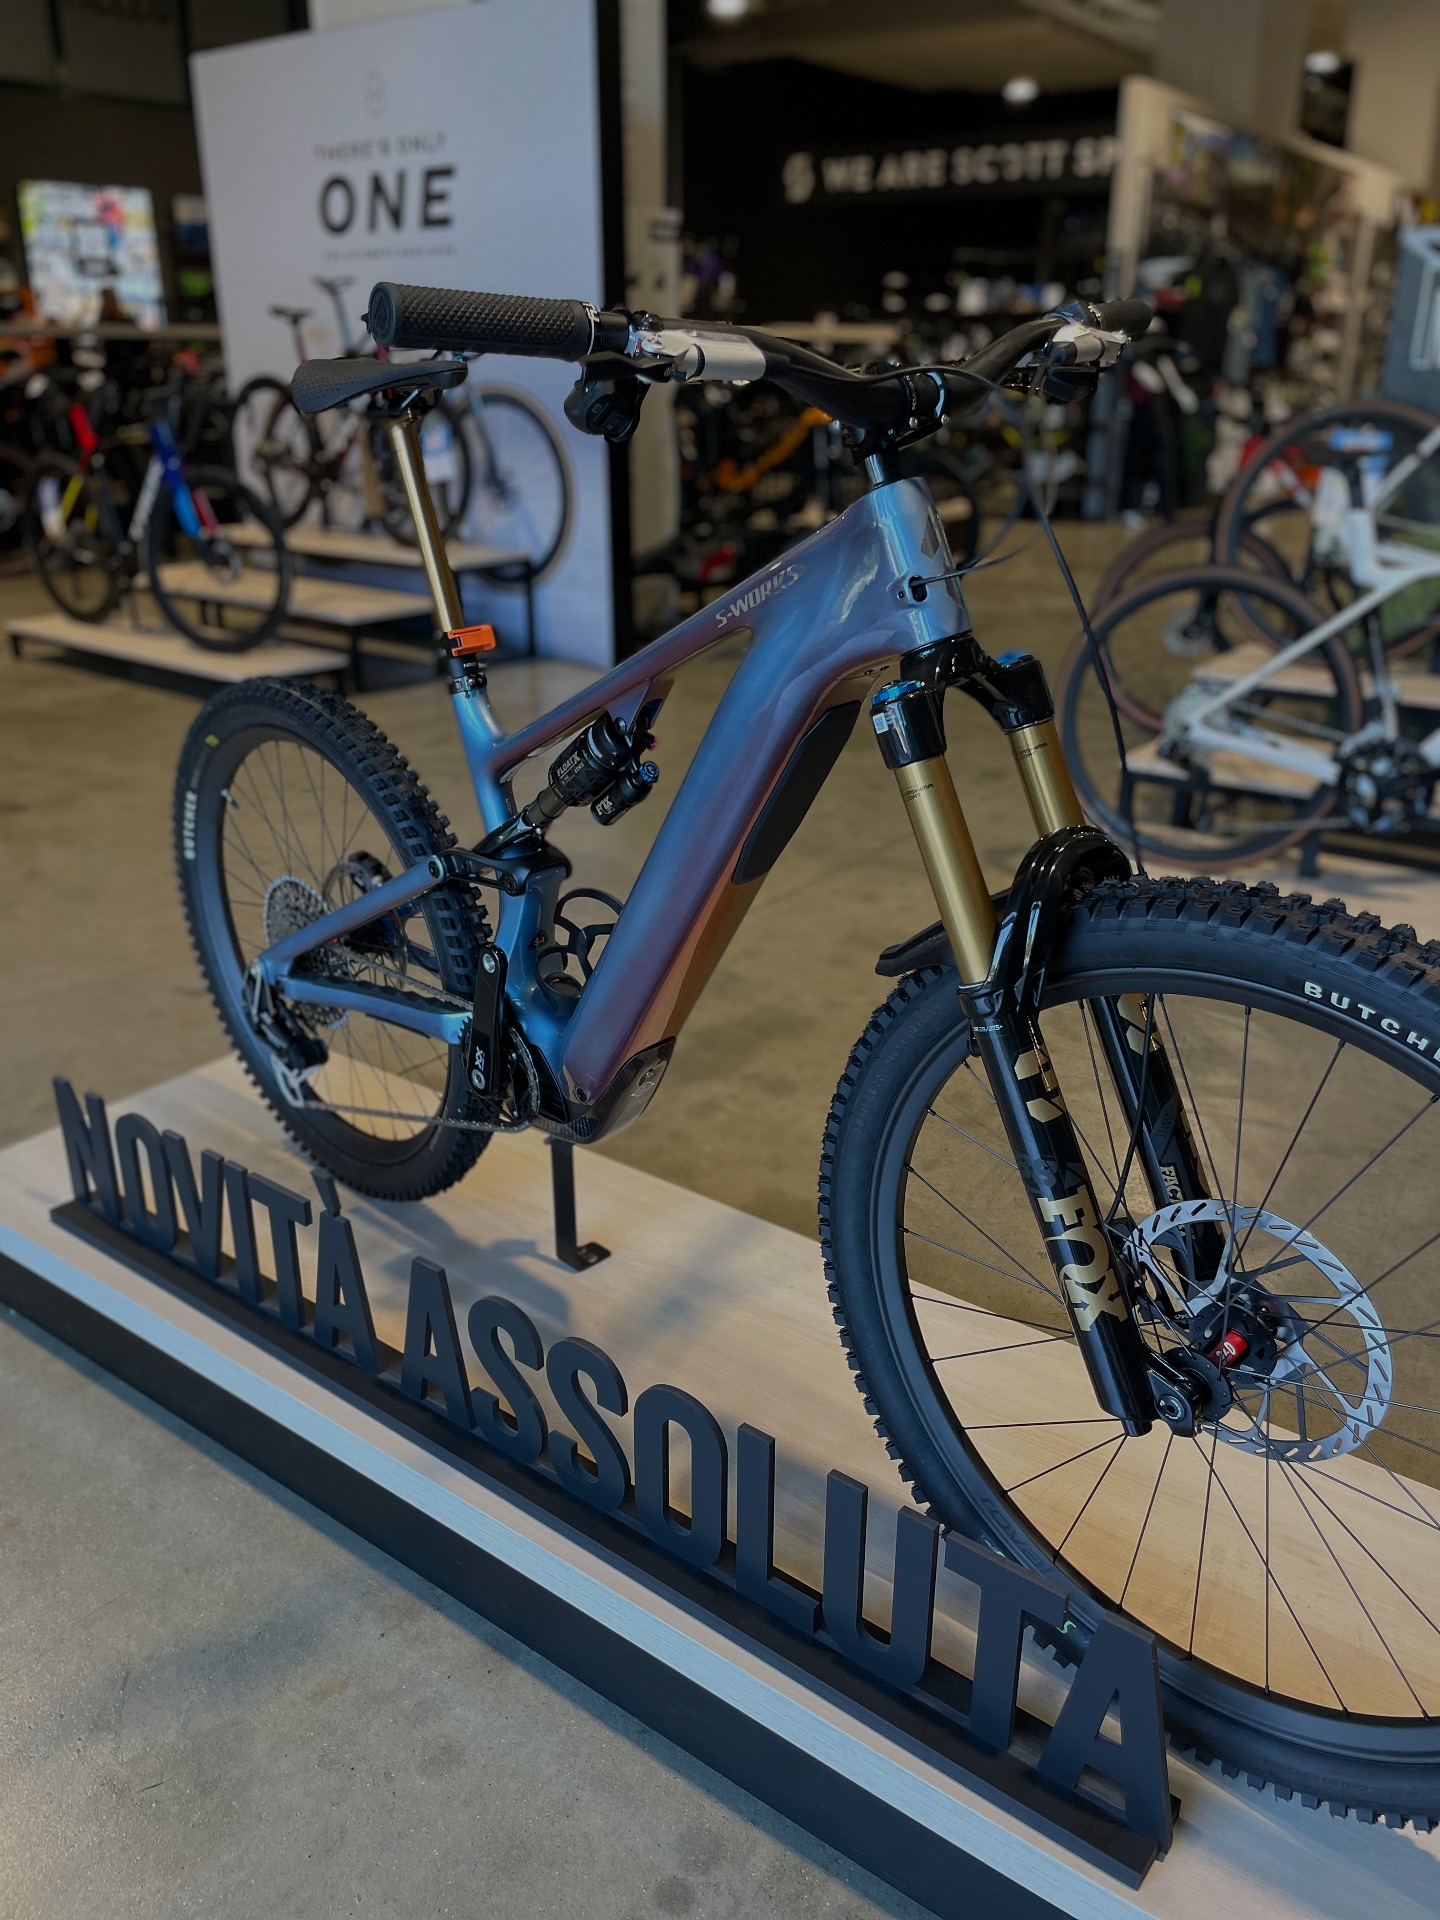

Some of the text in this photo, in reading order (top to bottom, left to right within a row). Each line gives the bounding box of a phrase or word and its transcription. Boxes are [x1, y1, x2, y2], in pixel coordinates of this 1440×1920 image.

[821, 153, 875, 194] WE
[875, 147, 948, 191] ARE
[949, 137, 1069, 186] SCOTT
[319, 167, 456, 236] ONE
[715, 563, 799, 629] S-WORKS
[1036, 1183, 1130, 1332] FOX
[53, 1076, 1174, 1861] NOVITÀ ASSOLUTA
